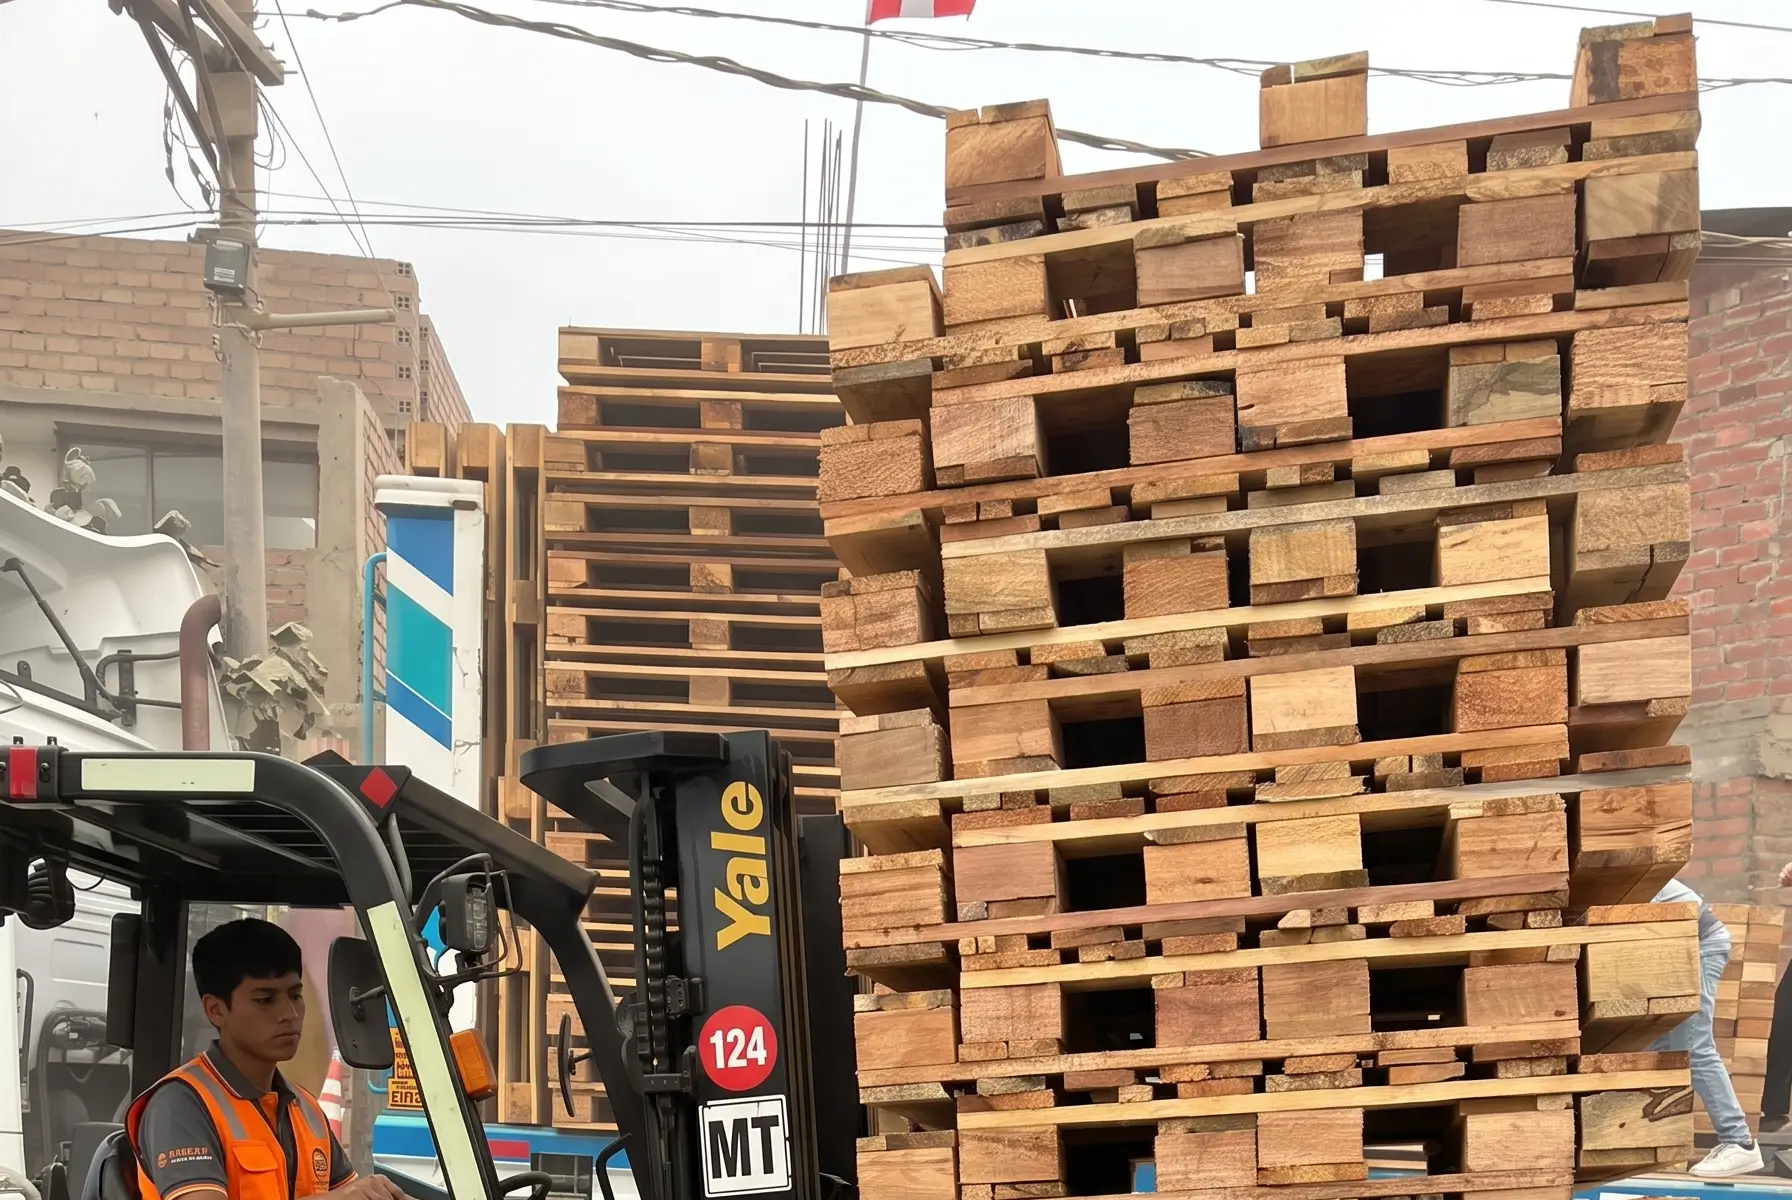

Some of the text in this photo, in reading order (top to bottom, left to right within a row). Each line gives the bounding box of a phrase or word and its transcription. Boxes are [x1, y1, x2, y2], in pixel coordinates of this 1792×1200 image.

[710, 781, 771, 951] Yale
[710, 1026, 767, 1069] 124
[708, 1114, 779, 1179] MT
